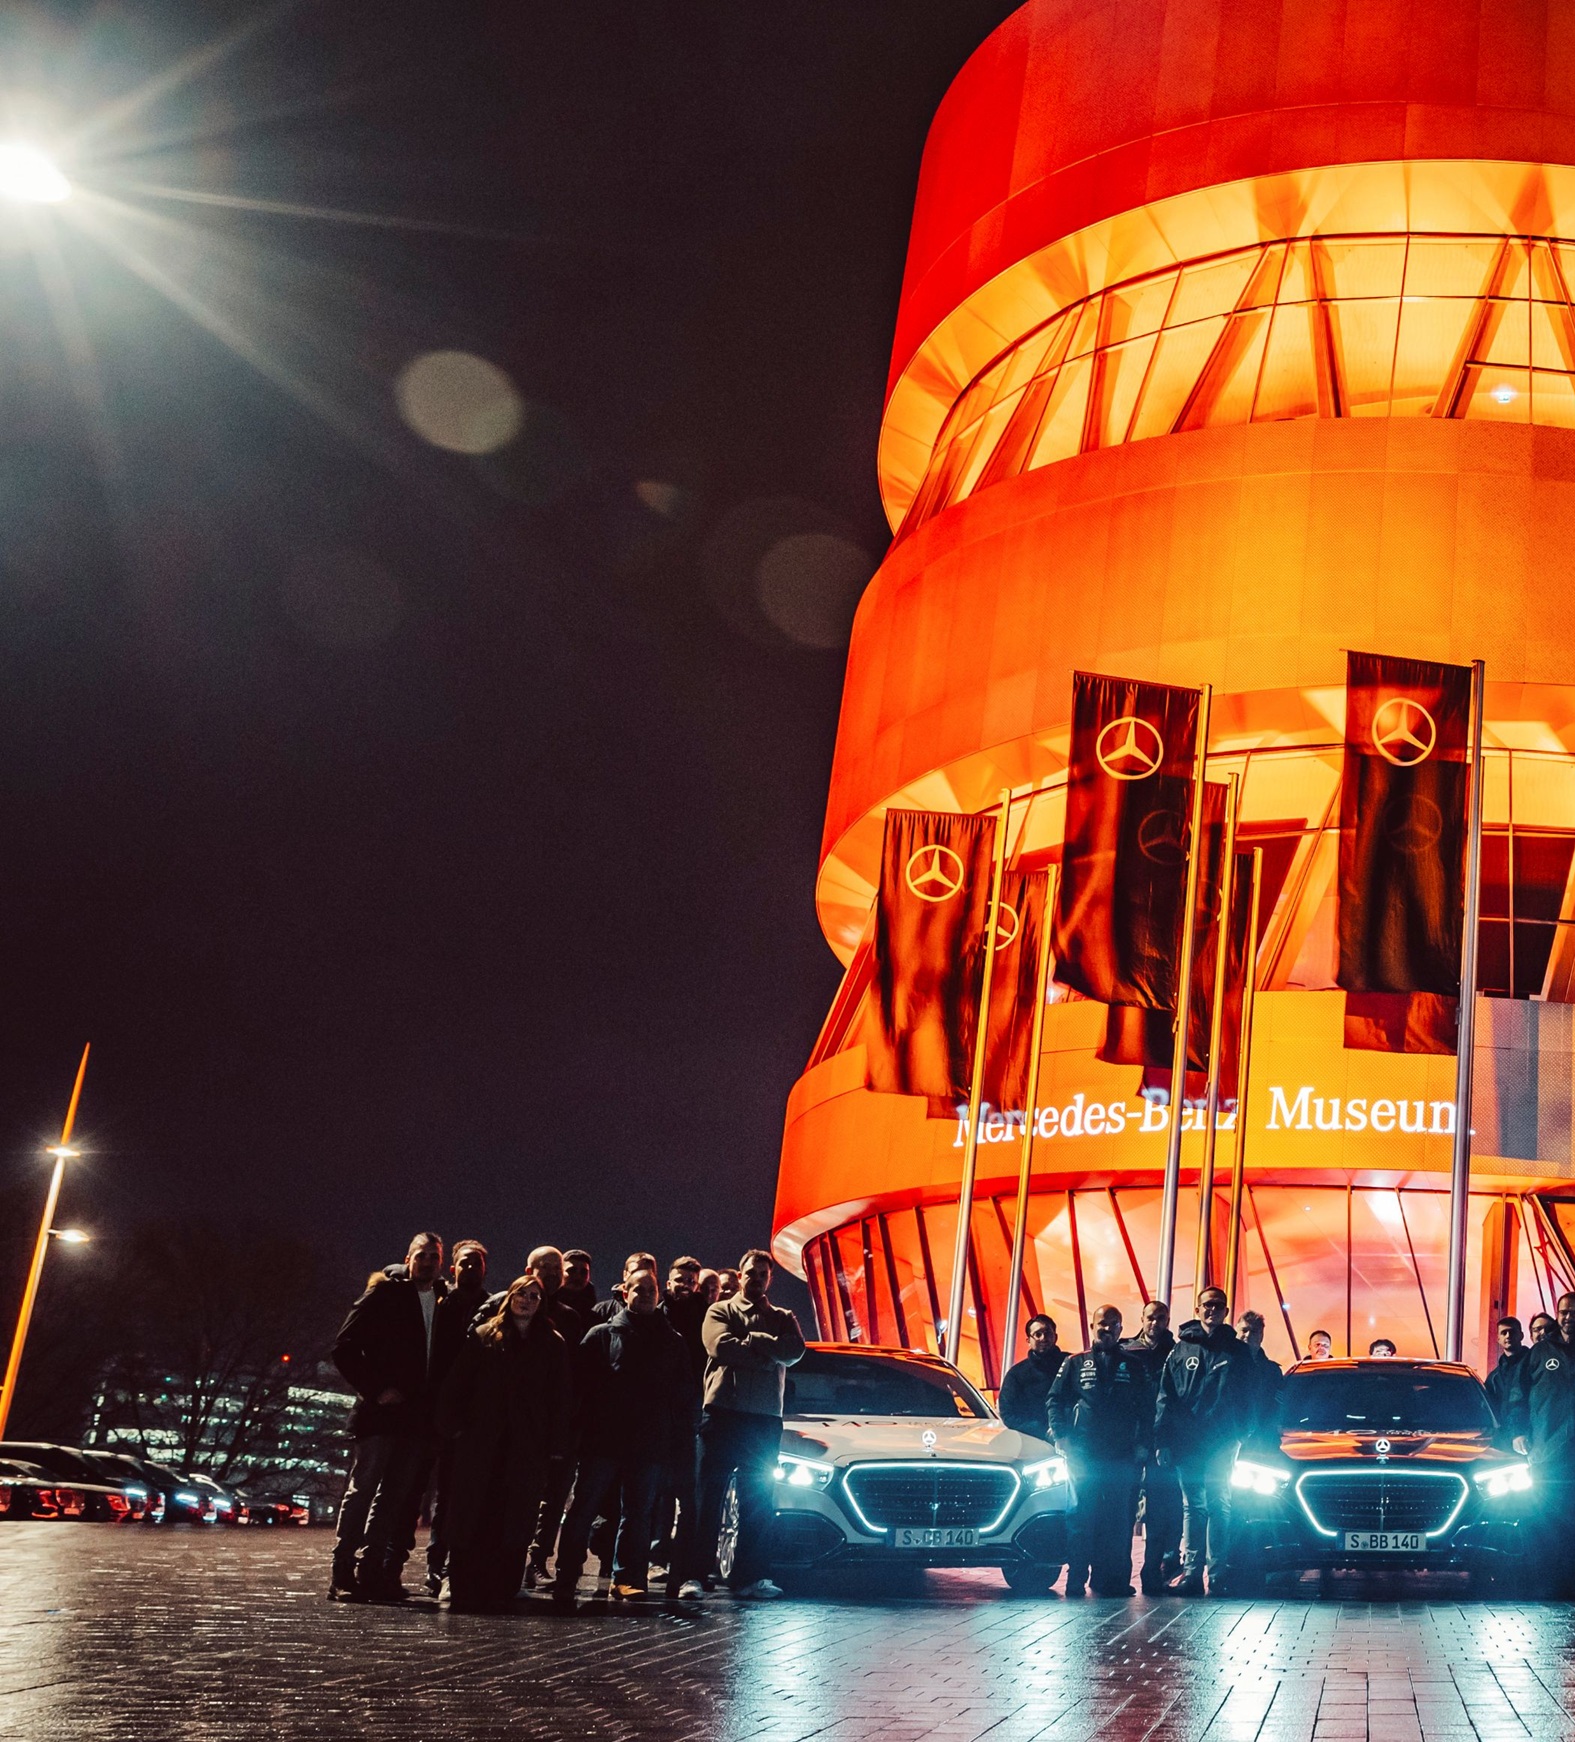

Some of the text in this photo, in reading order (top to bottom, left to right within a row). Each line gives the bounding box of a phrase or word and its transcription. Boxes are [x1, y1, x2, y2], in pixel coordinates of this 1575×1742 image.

[902, 1530, 912, 1546] S
[946, 1530, 974, 1546] 140
[1350, 1534, 1419, 1549] S BB 140
